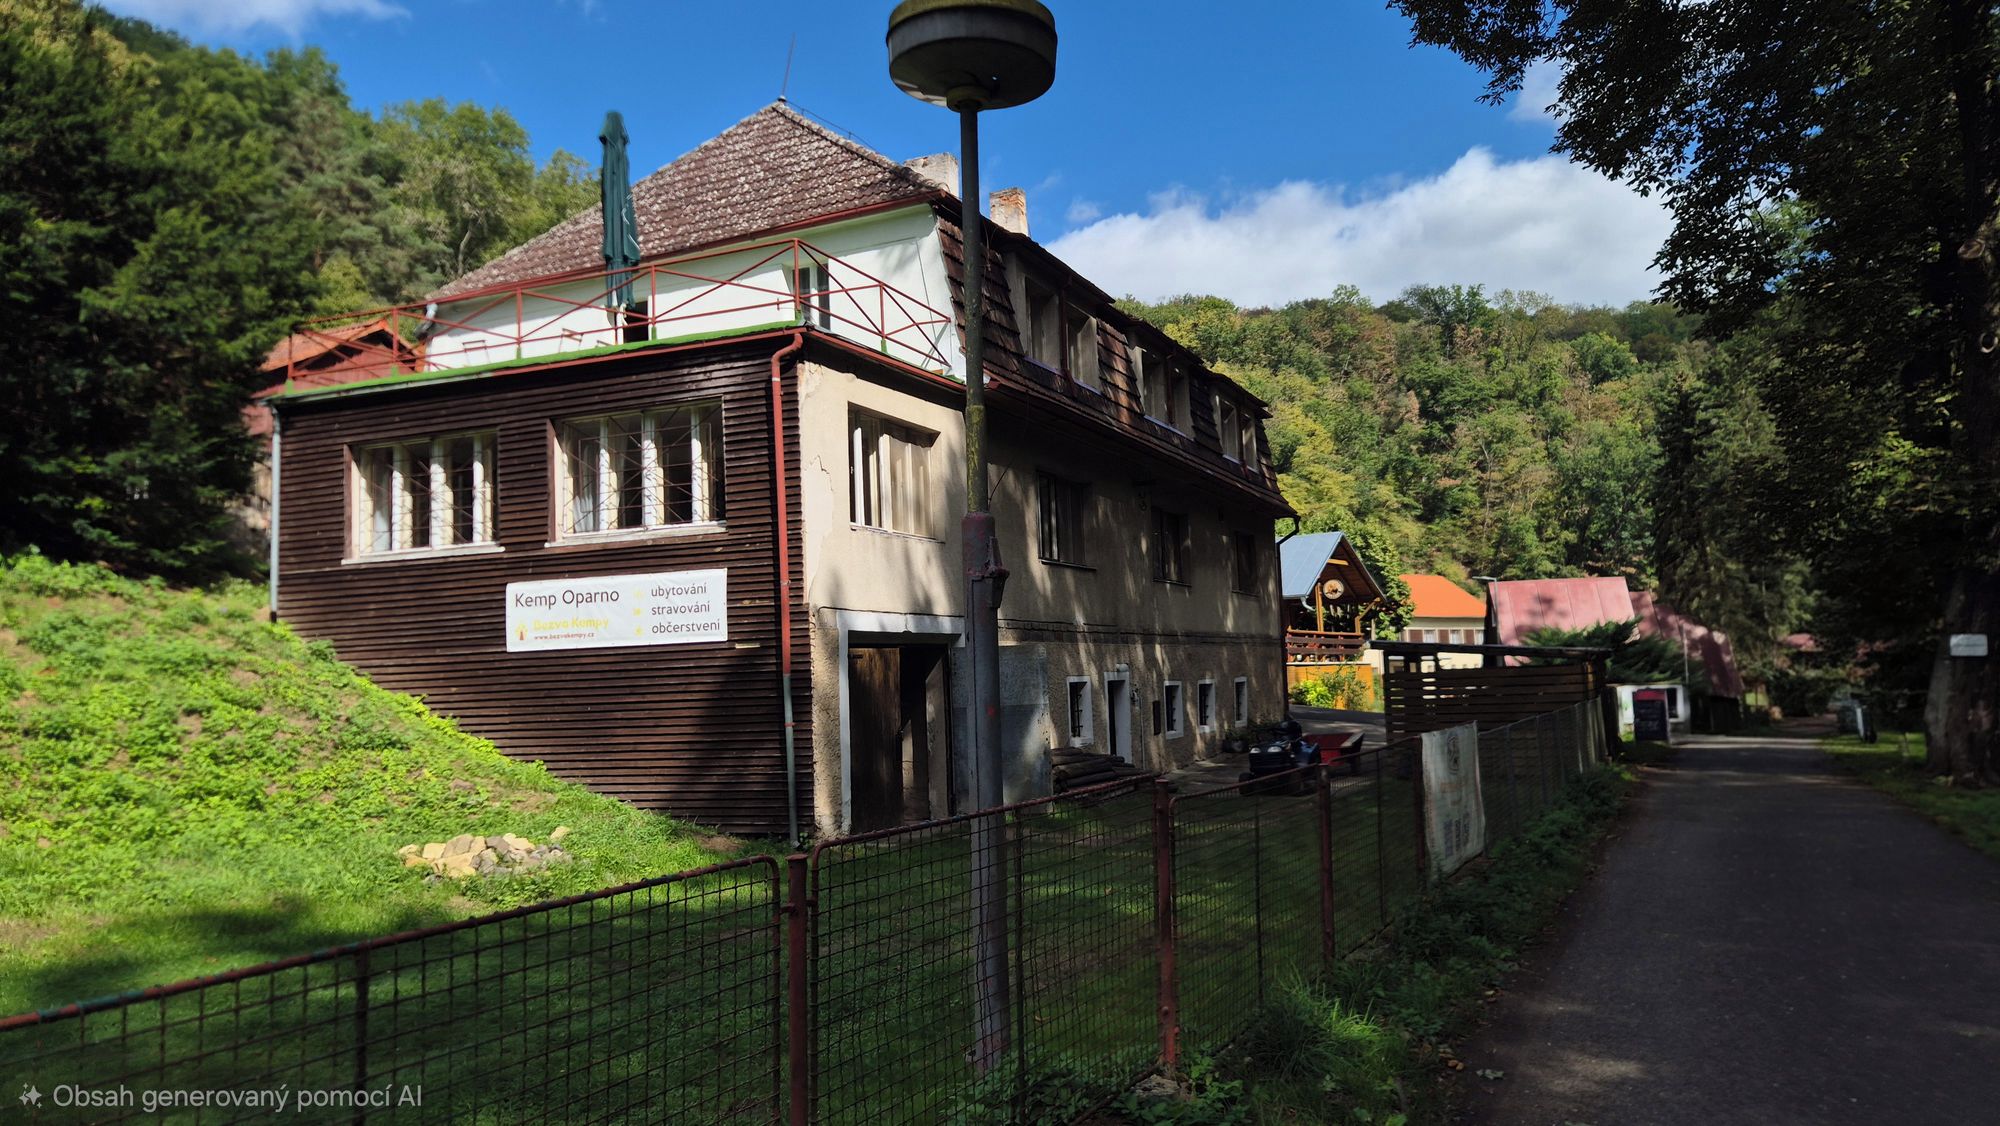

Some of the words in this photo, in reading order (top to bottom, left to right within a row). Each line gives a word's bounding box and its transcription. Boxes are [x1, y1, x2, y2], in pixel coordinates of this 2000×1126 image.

[515, 593, 557, 609] Kemp
[562, 589, 620, 609] Oparno
[651, 582, 708, 599] ubytování
[651, 601, 711, 616] stravování
[652, 618, 721, 635] občerstvení
